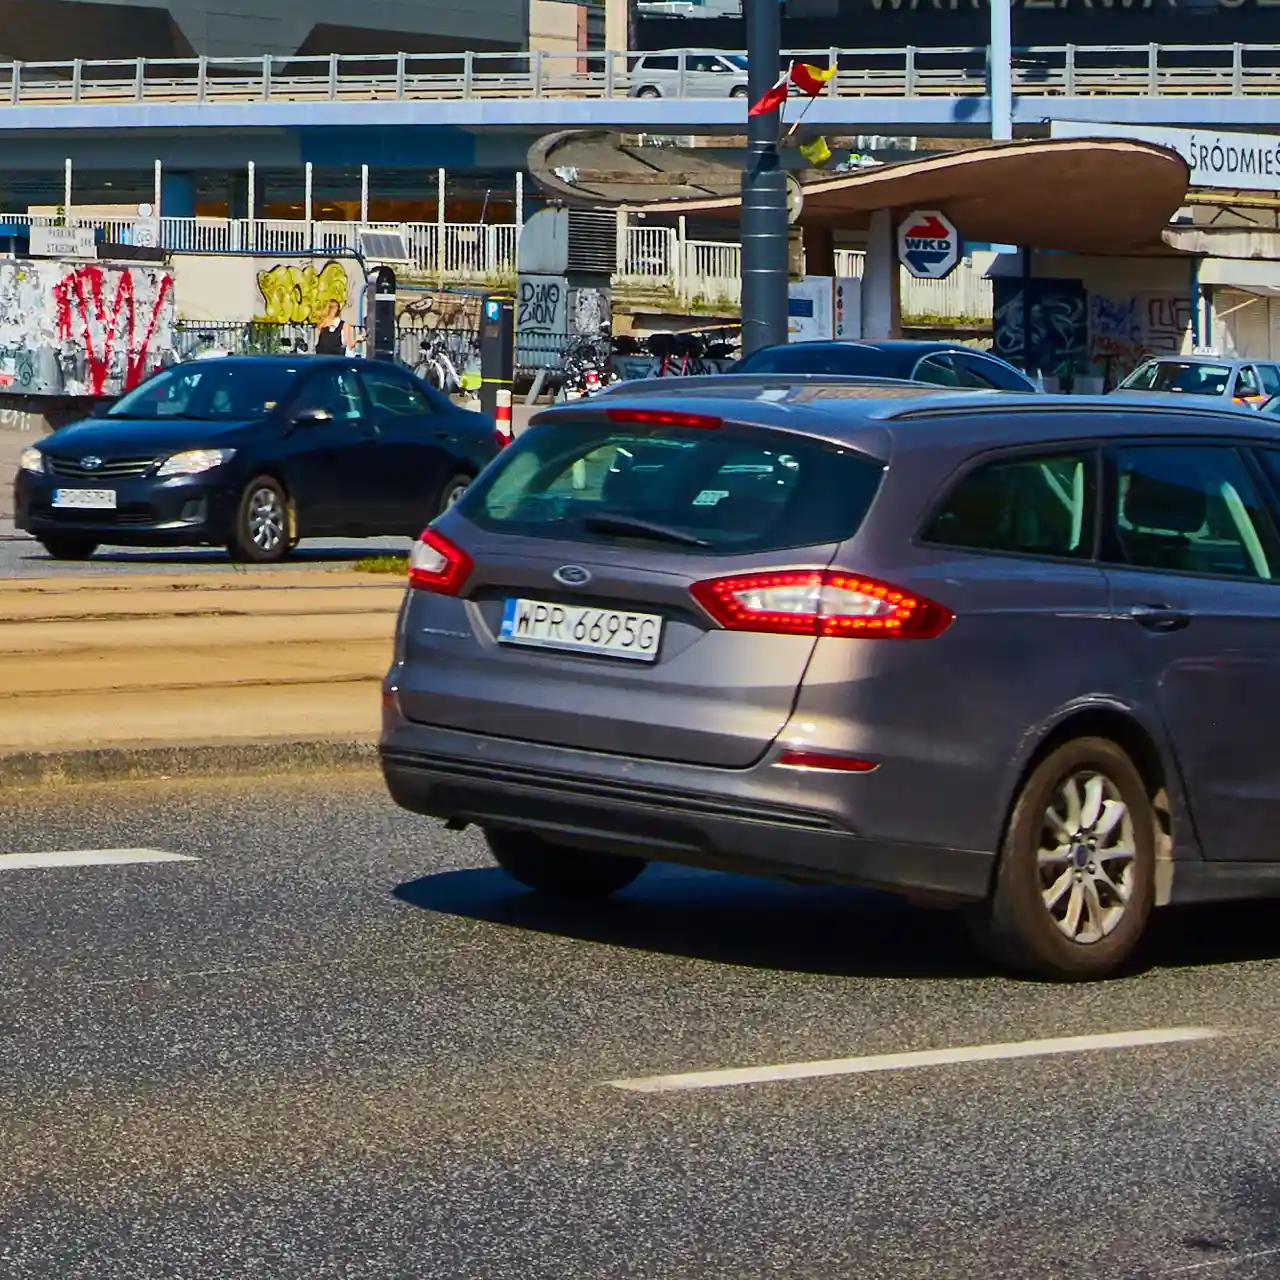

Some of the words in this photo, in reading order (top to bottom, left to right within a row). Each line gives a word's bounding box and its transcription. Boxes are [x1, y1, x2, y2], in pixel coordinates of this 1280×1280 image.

[905, 238, 951, 251] WKD
[517, 603, 565, 640] WPR
[573, 610, 656, 650] 6695G
